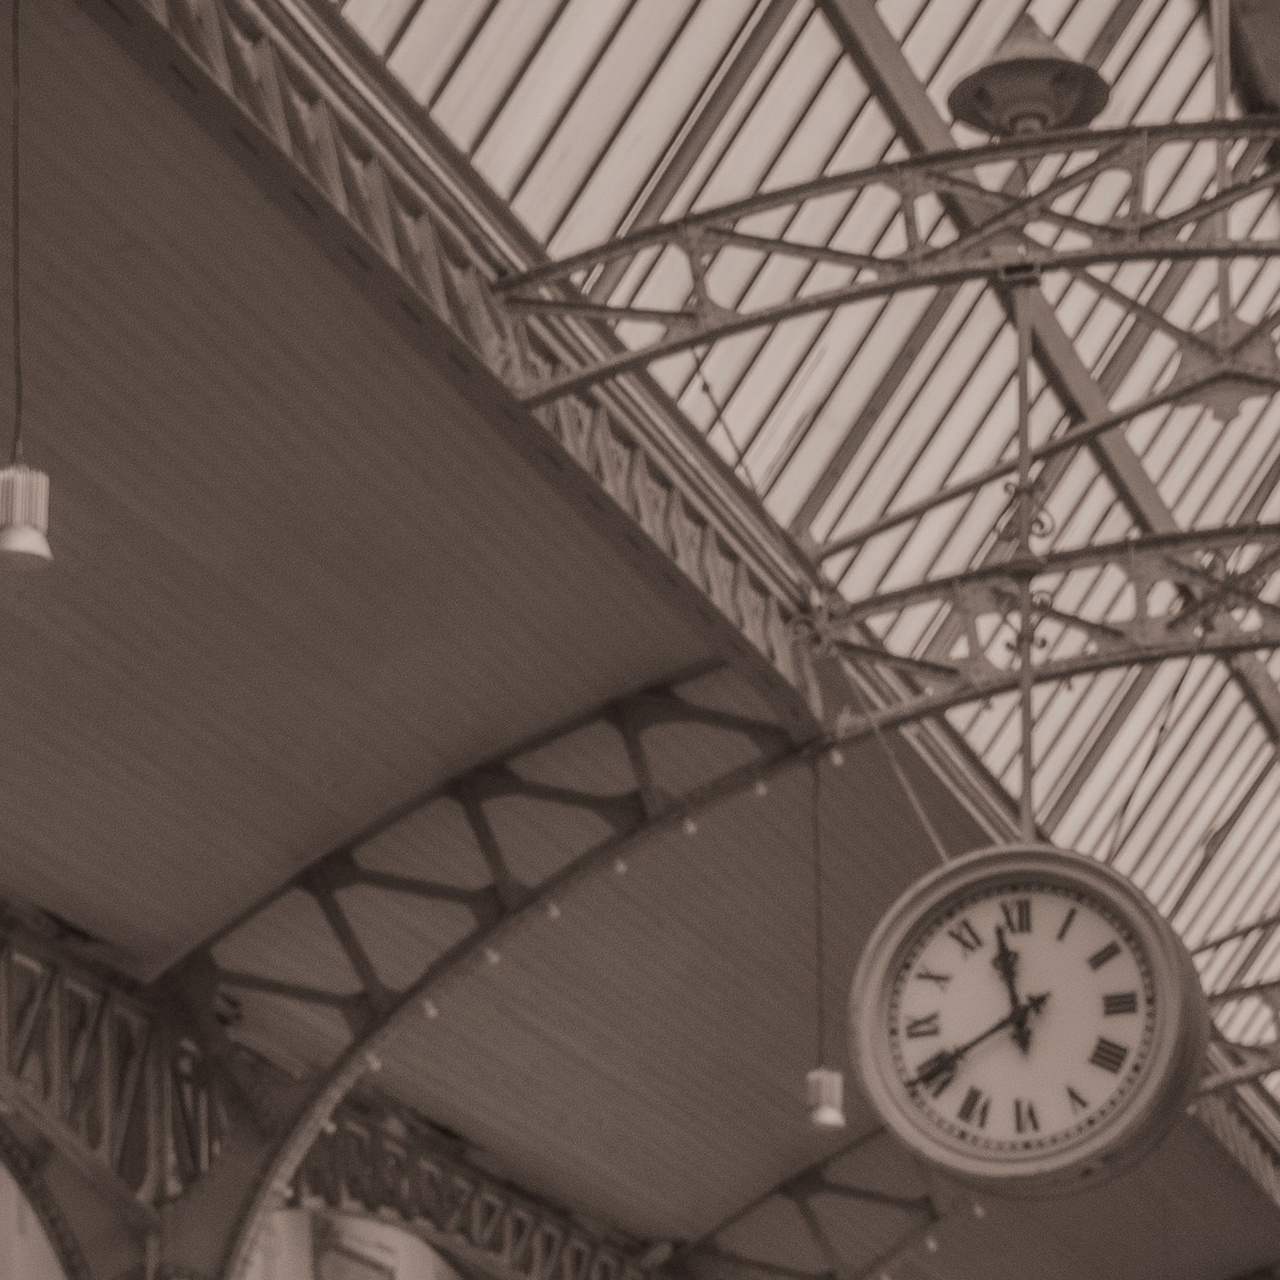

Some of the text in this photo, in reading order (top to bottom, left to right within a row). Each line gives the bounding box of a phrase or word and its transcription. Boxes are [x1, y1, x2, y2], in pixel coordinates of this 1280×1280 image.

[1087, 940, 1122, 971] II
[1103, 992, 1138, 1016] III
[1088, 1036, 1128, 1075] IIII
